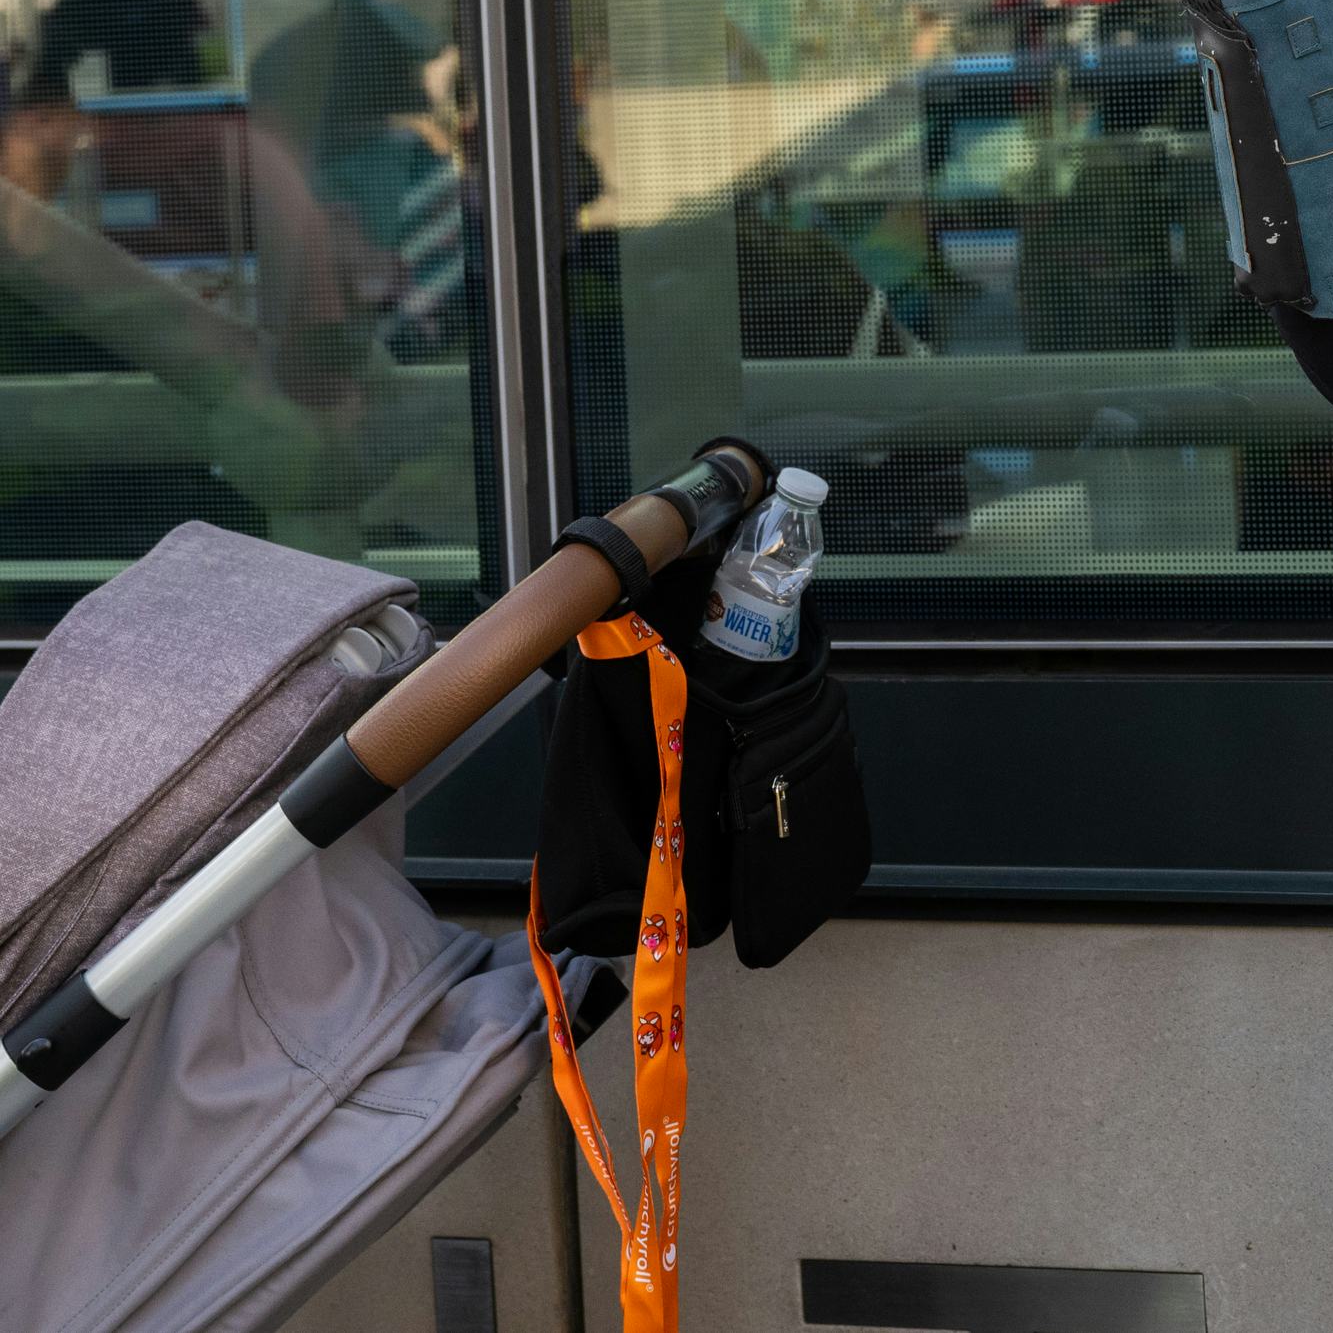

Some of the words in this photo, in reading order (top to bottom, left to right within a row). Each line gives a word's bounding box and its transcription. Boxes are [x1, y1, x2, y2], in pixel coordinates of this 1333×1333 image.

[724, 608, 772, 644] WATER
[733, 603, 770, 624] PURIFIED
[665, 1121, 681, 1238] crunchyroll
